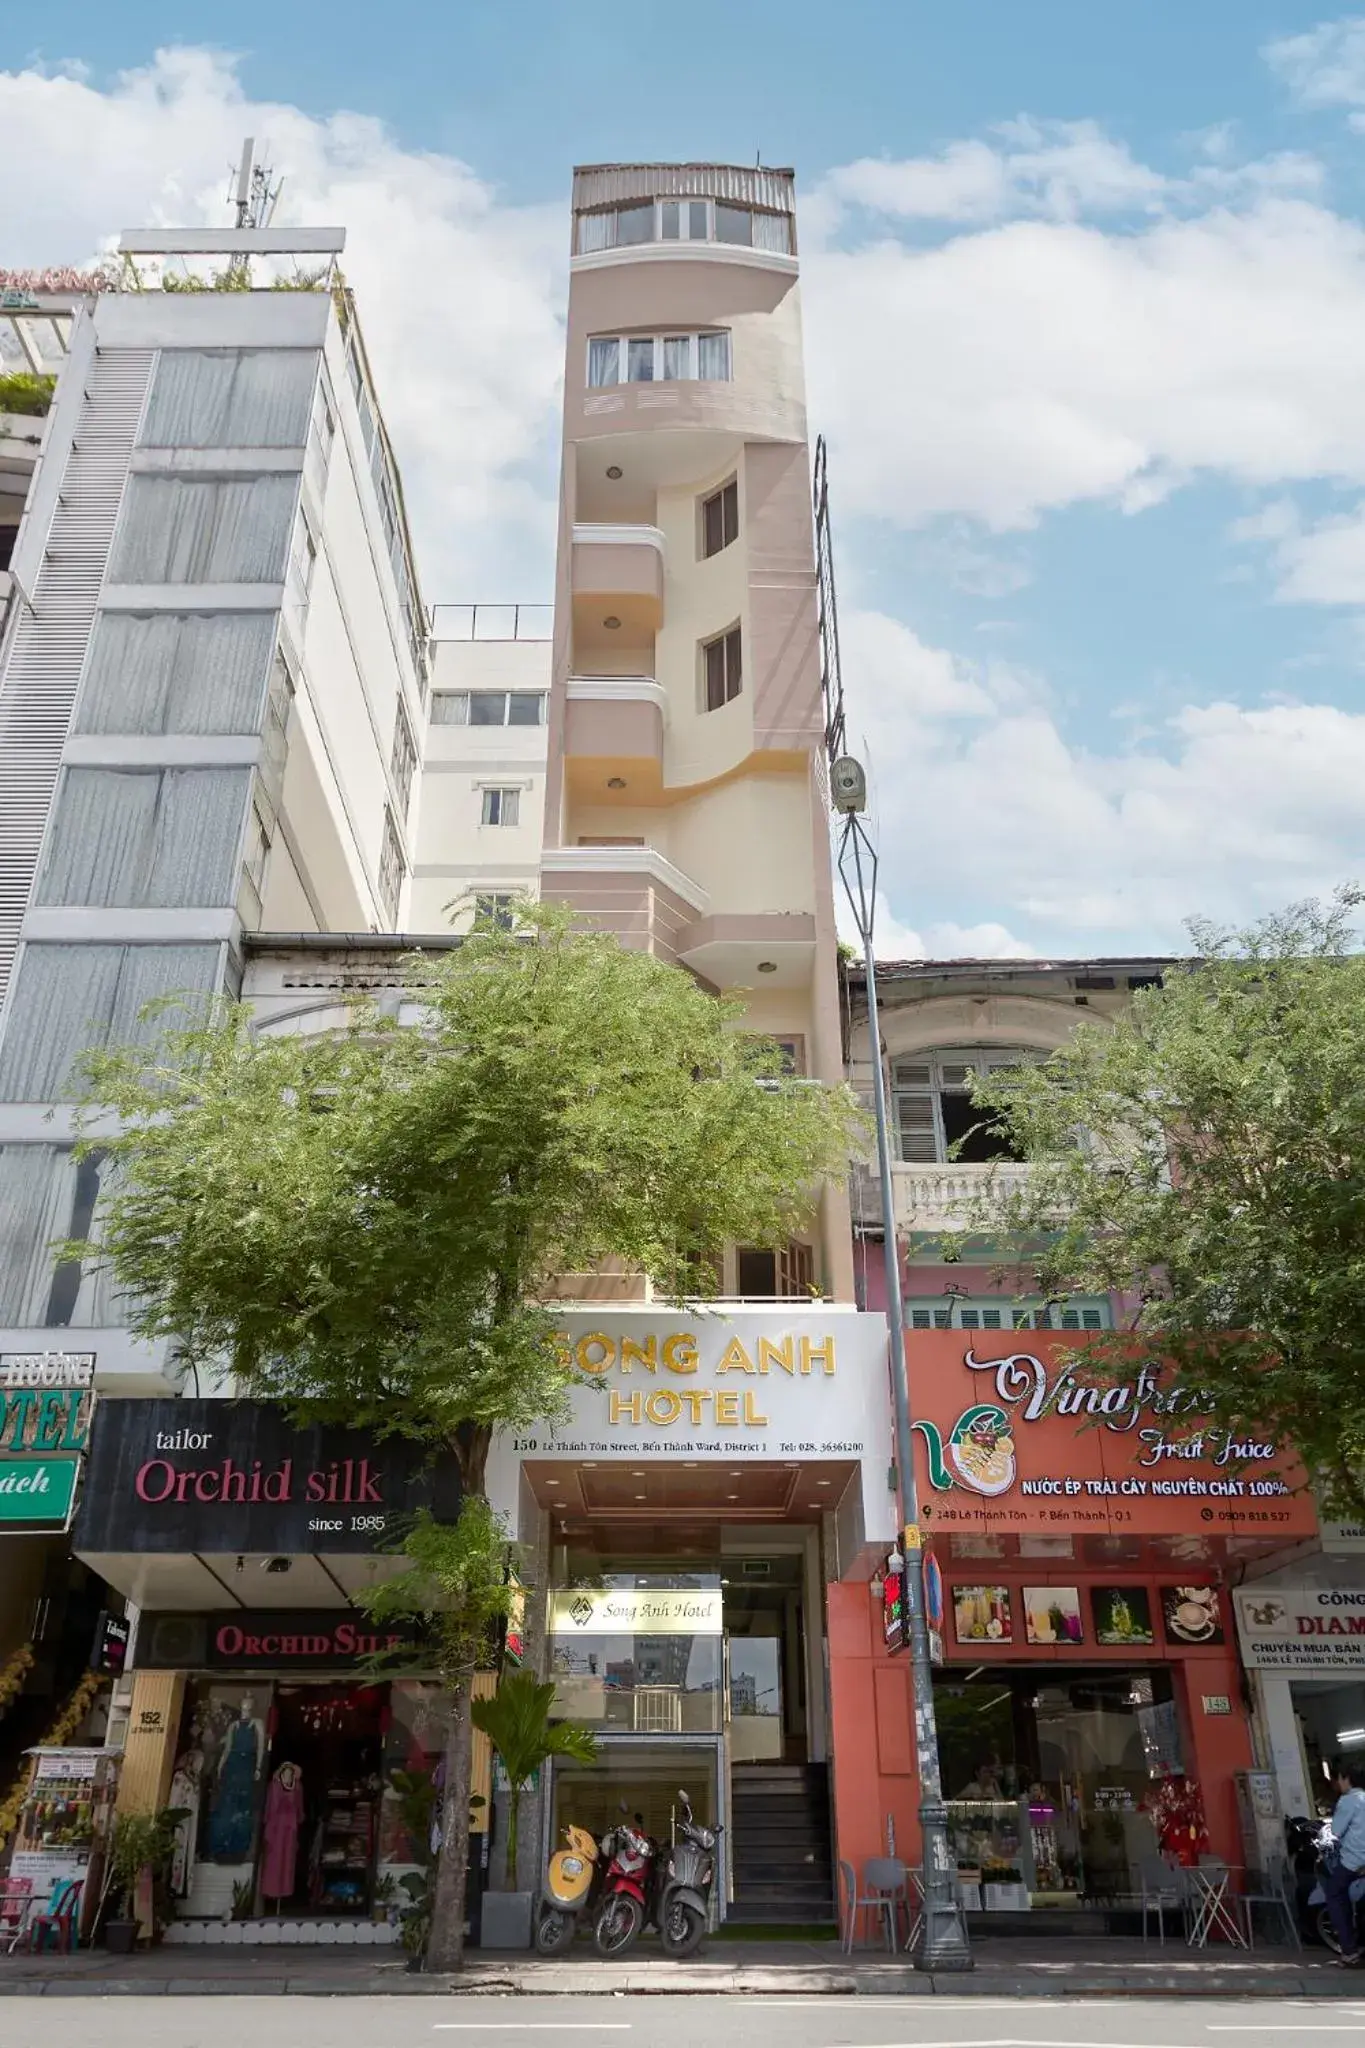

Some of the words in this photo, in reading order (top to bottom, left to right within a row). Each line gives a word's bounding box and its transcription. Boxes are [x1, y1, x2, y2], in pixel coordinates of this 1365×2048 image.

[716, 1334, 836, 1376] ANH
[609, 1389, 769, 1426] HOTEL
[0, 1389, 88, 1452] TEL
[156, 1428, 212, 1450] tailor
[513, 1439, 537, 1451] 150
[610, 1441, 639, 1453] Street,
[696, 1442, 722, 1453] Ward,
[725, 1442, 759, 1452] District
[135, 1458, 292, 1503] Orchid
[304, 1458, 384, 1503] silk
[1022, 1477, 1062, 1495] NƯỚC
[1065, 1476, 1081, 1495] ÉP
[1085, 1477, 1118, 1495] TRÁI
[1121, 1477, 1147, 1495] CÂY
[1151, 1477, 1207, 1495] NGUYÊN
[1248, 1481, 1288, 1496] 100%
[308, 1517, 343, 1530] since
[350, 1516, 385, 1530] 1985
[603, 1603, 637, 1621] Song
[216, 1625, 331, 1655] ORCHID
[1304, 1643, 1332, 1653] MUA
[141, 1711, 161, 1724] 152
